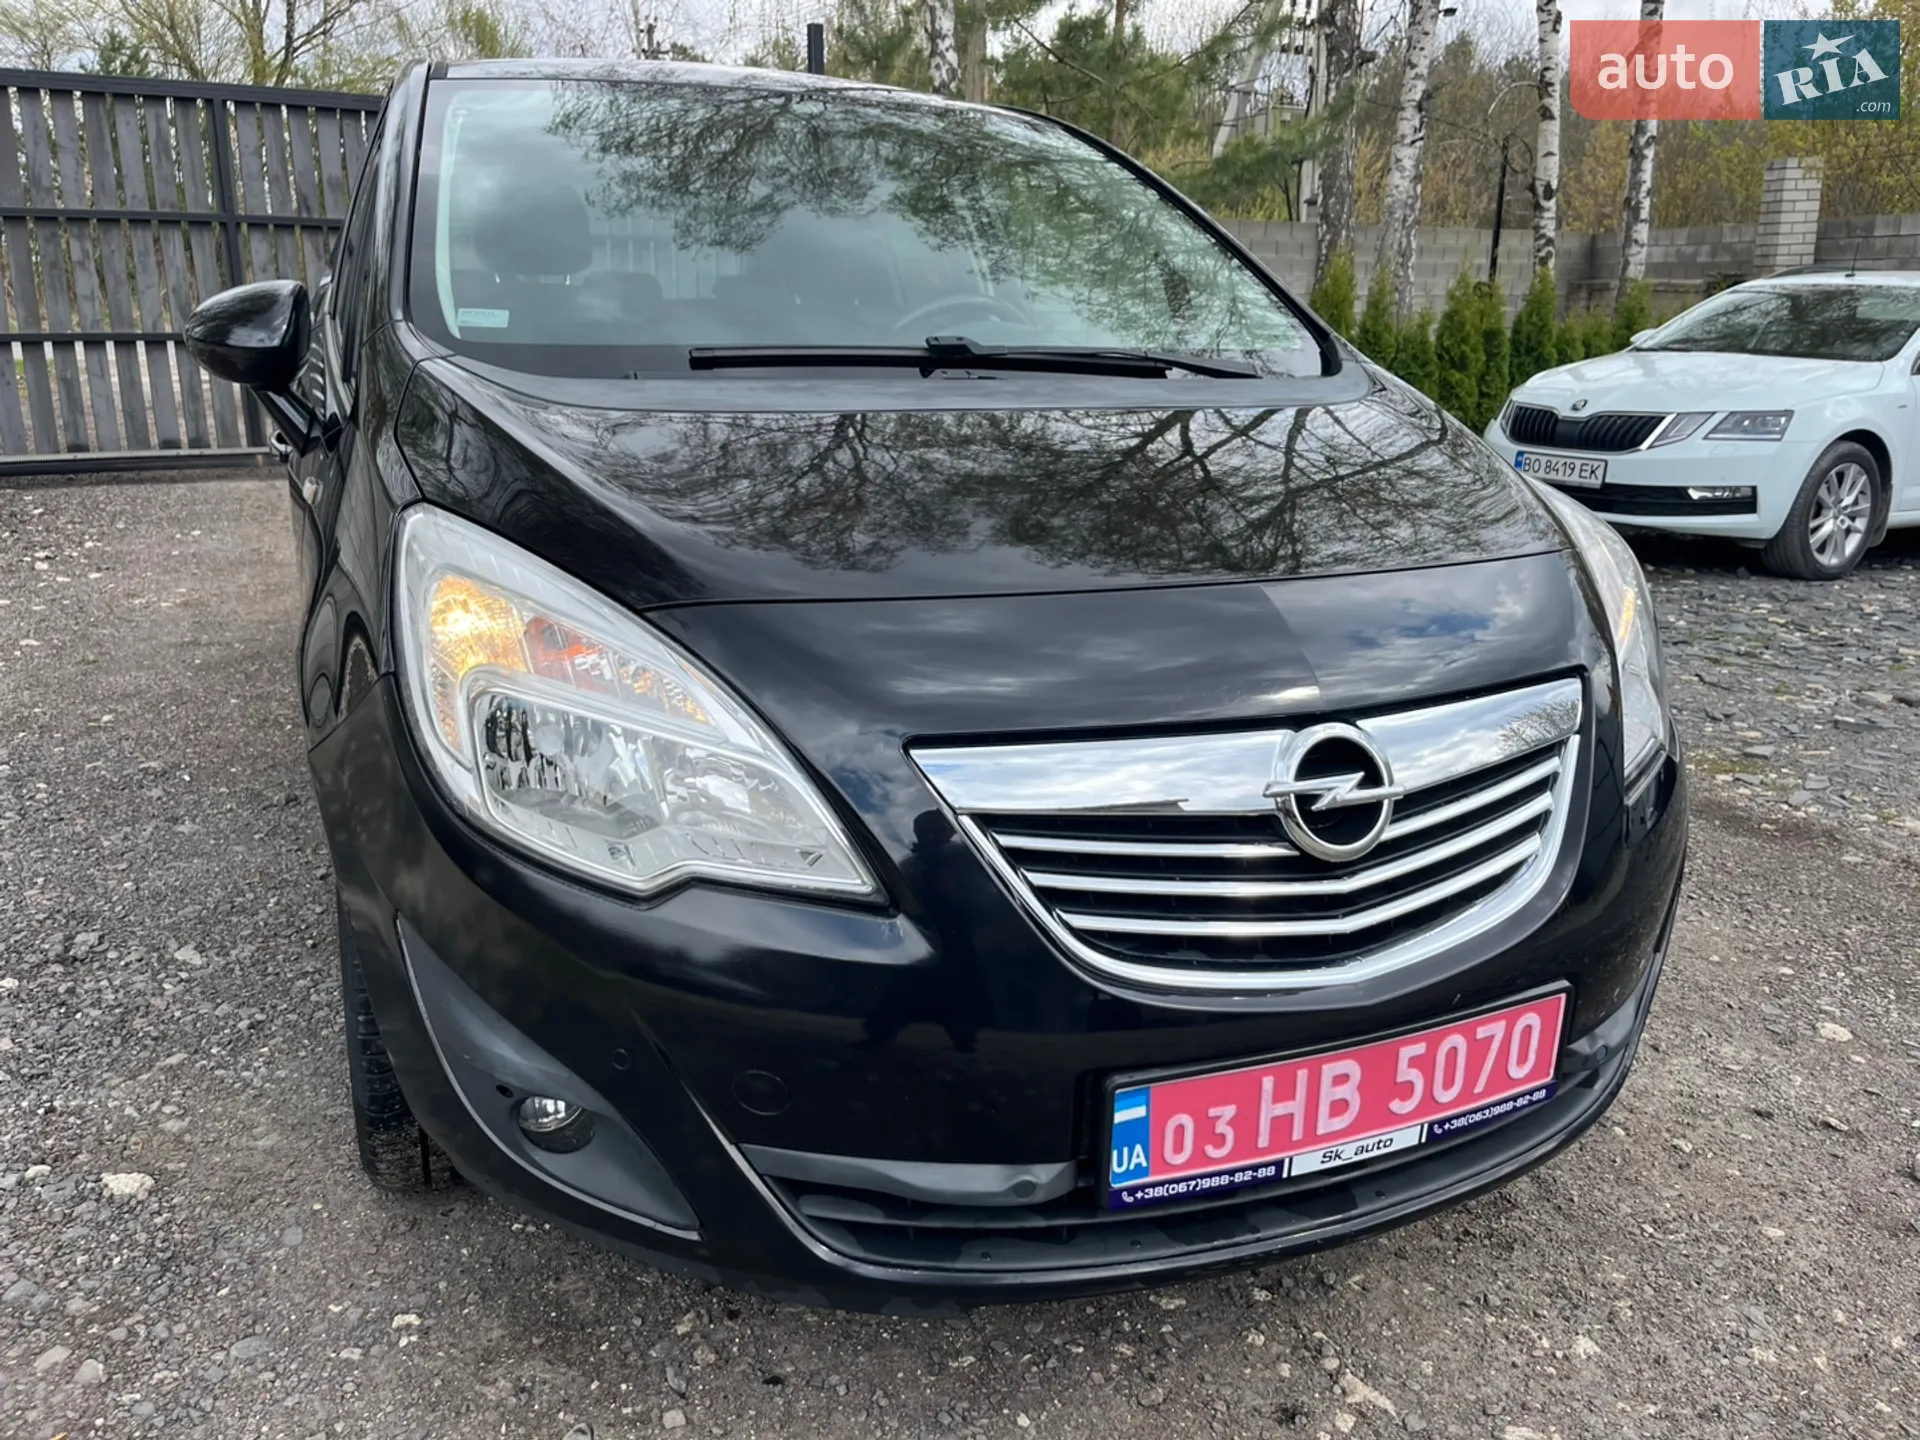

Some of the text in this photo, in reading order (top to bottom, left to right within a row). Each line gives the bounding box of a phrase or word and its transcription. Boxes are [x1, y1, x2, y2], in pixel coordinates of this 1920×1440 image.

[1523, 457, 1601, 480] BO 8419 EK
[1163, 1011, 1542, 1166] 03 HB 5070
[1112, 1143, 1148, 1175] UA
[1319, 1136, 1394, 1165] Sk_auto
[1134, 1165, 1276, 1201] +38(067)988-82-88
